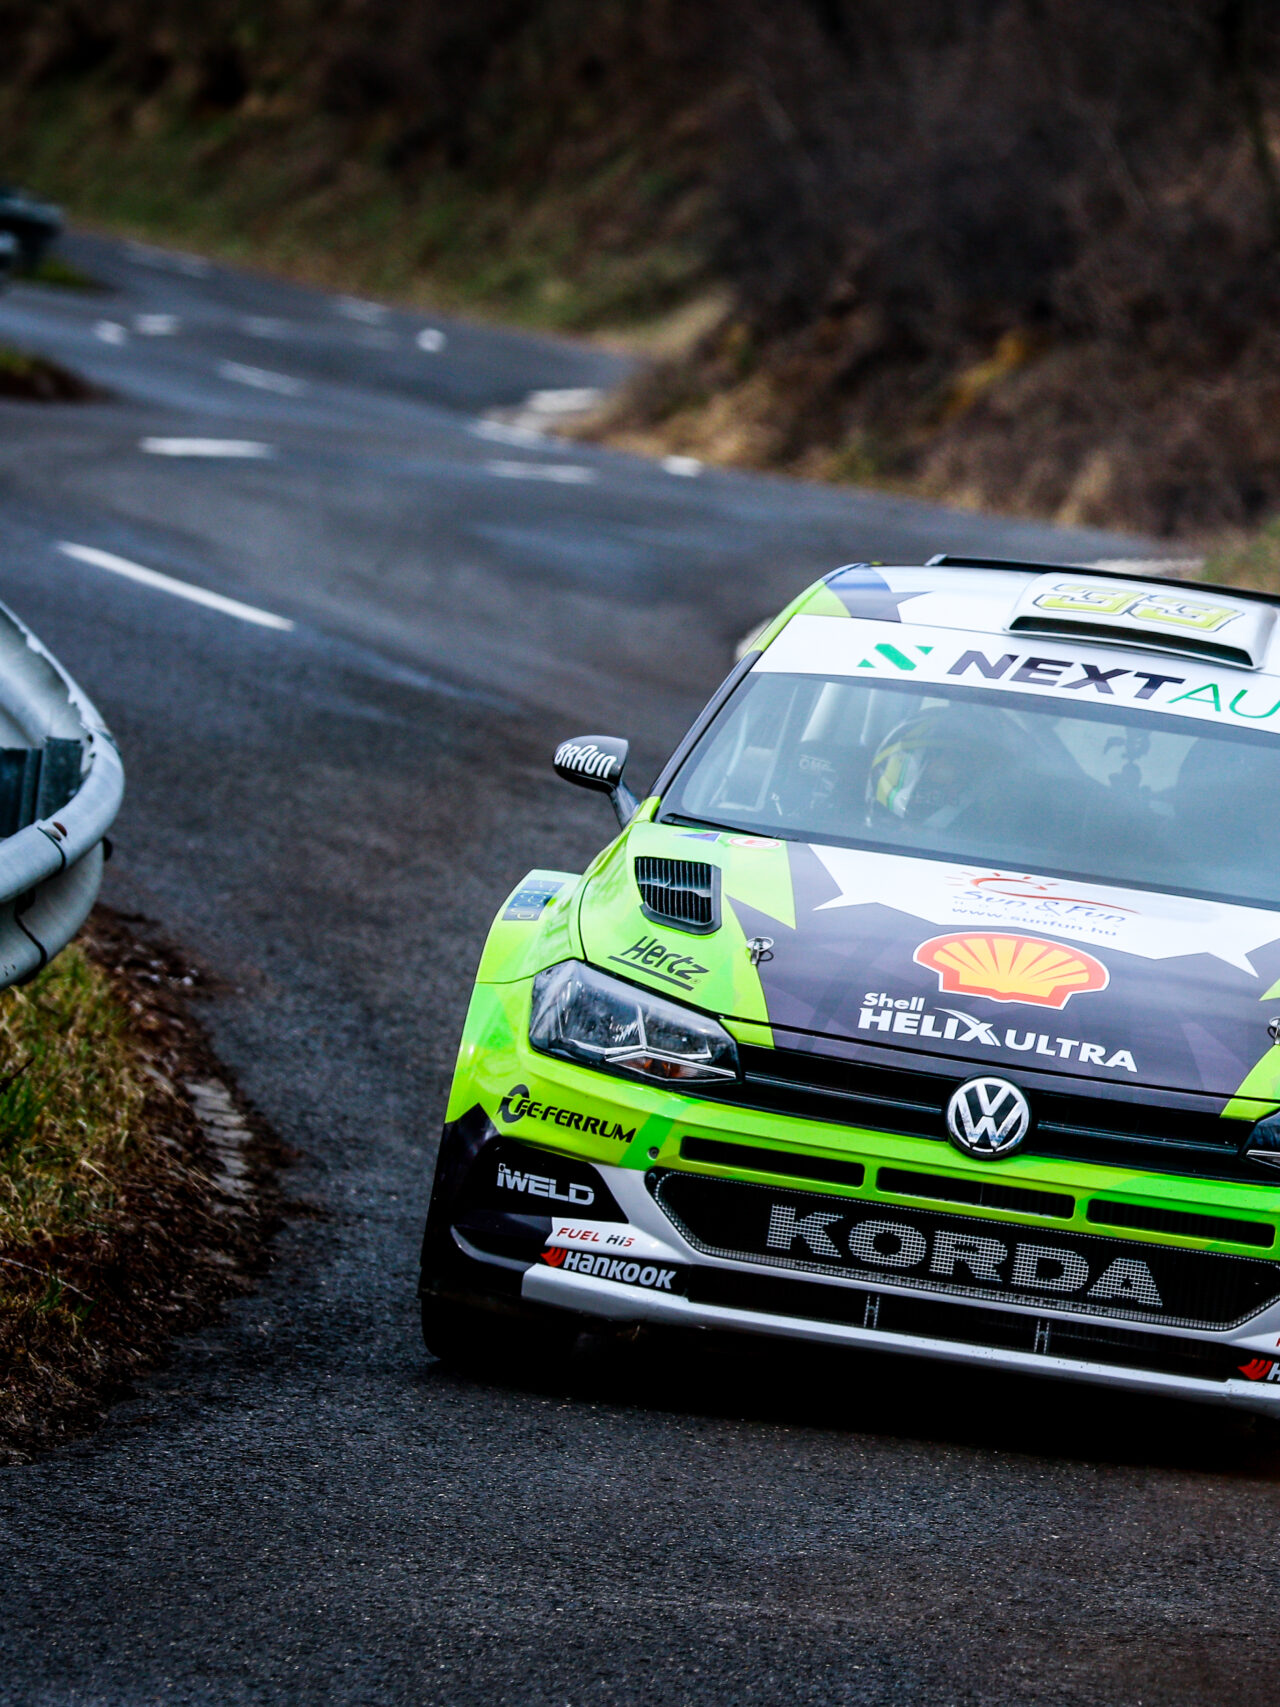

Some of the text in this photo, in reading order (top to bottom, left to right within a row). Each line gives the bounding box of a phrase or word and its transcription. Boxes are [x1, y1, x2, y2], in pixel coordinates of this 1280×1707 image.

[952, 907, 1117, 936] www.sunfun.hu
[621, 936, 708, 980] Hertz
[863, 992, 925, 1012] Shell
[858, 1007, 1138, 1073] HELIX ULTRA
[557, 1227, 600, 1243] FUEL
[766, 1203, 1163, 1307] KORDA
